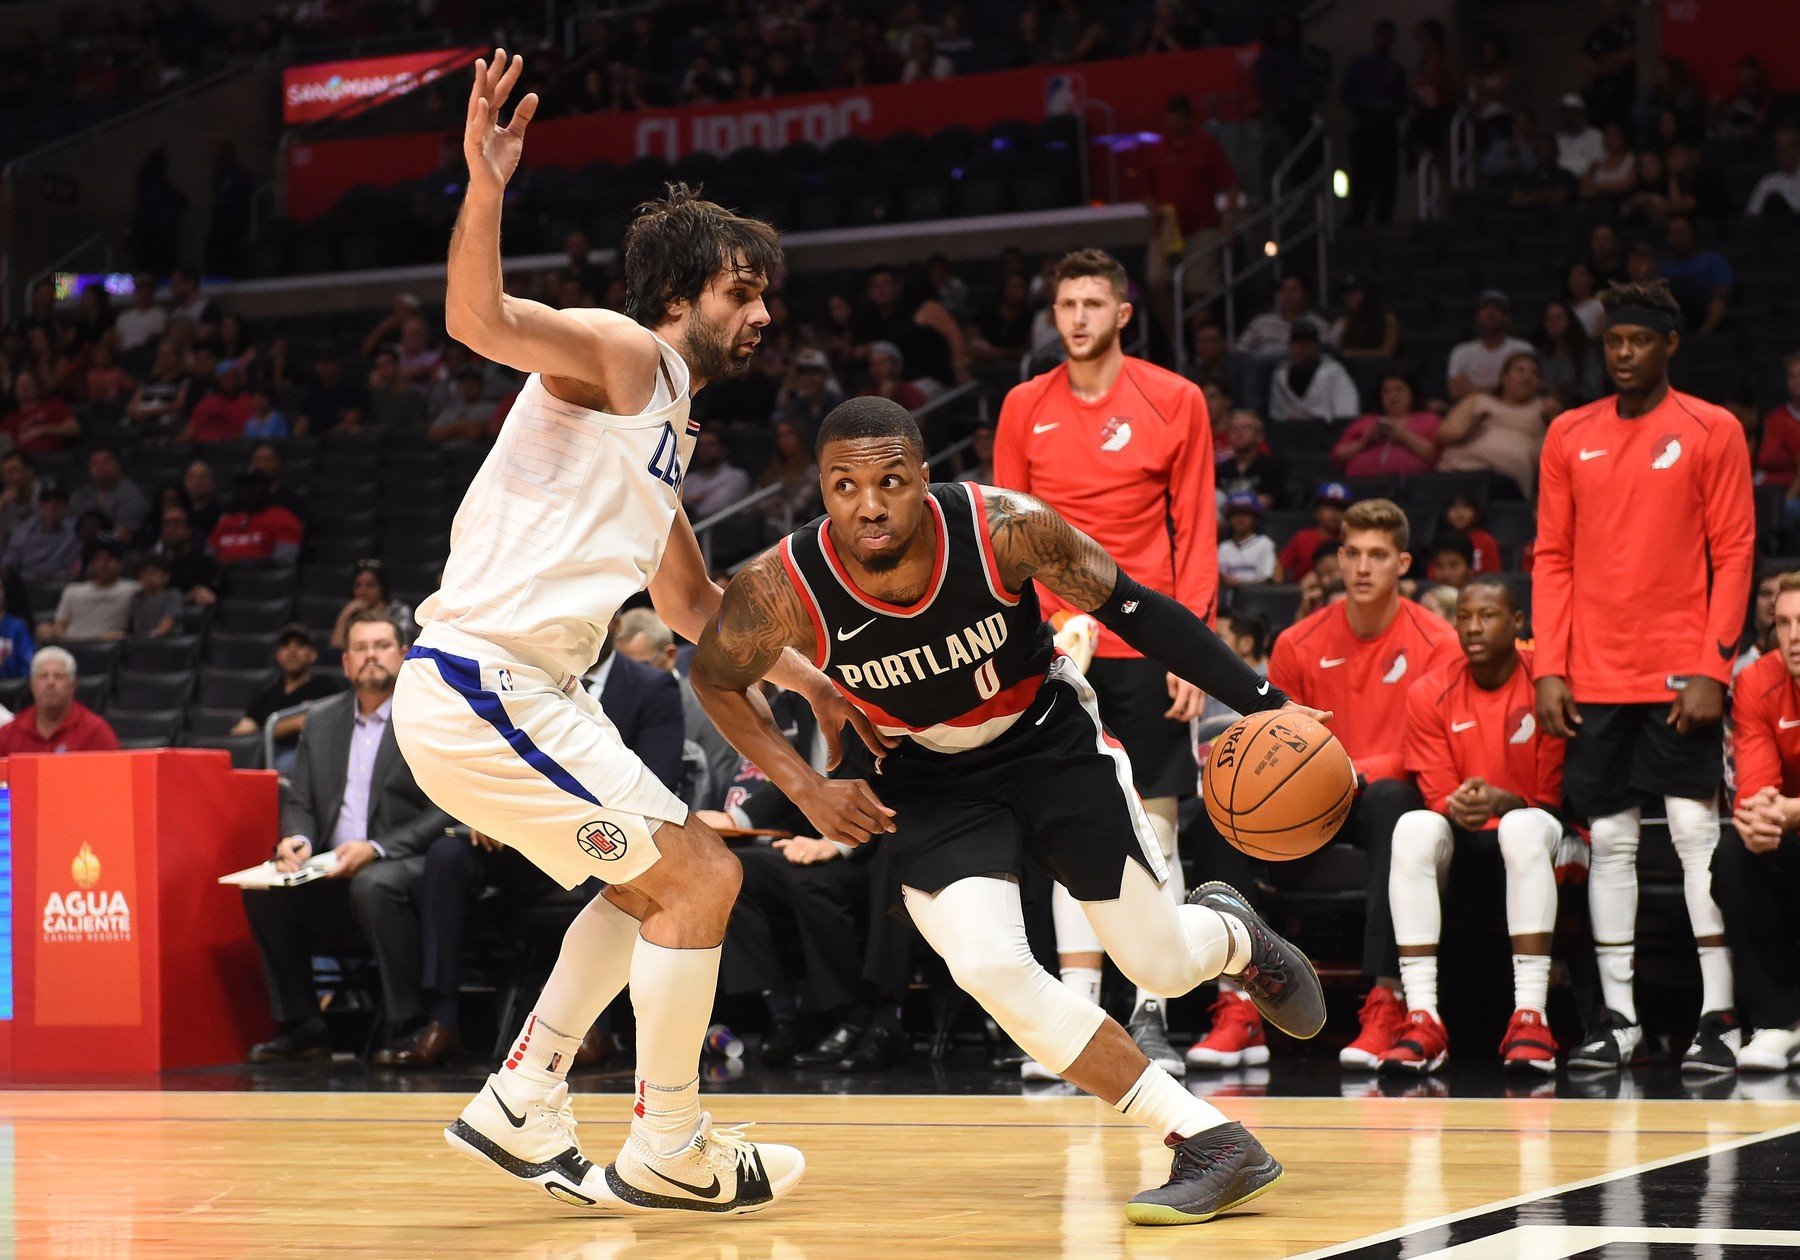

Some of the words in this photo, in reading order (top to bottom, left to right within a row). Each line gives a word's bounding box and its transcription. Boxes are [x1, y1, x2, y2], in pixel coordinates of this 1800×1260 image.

[836, 611, 1008, 690] PORTLAND
[974, 657, 1001, 700] 0
[43, 890, 130, 917] AGUA
[42, 914, 131, 933] CALIENTE
